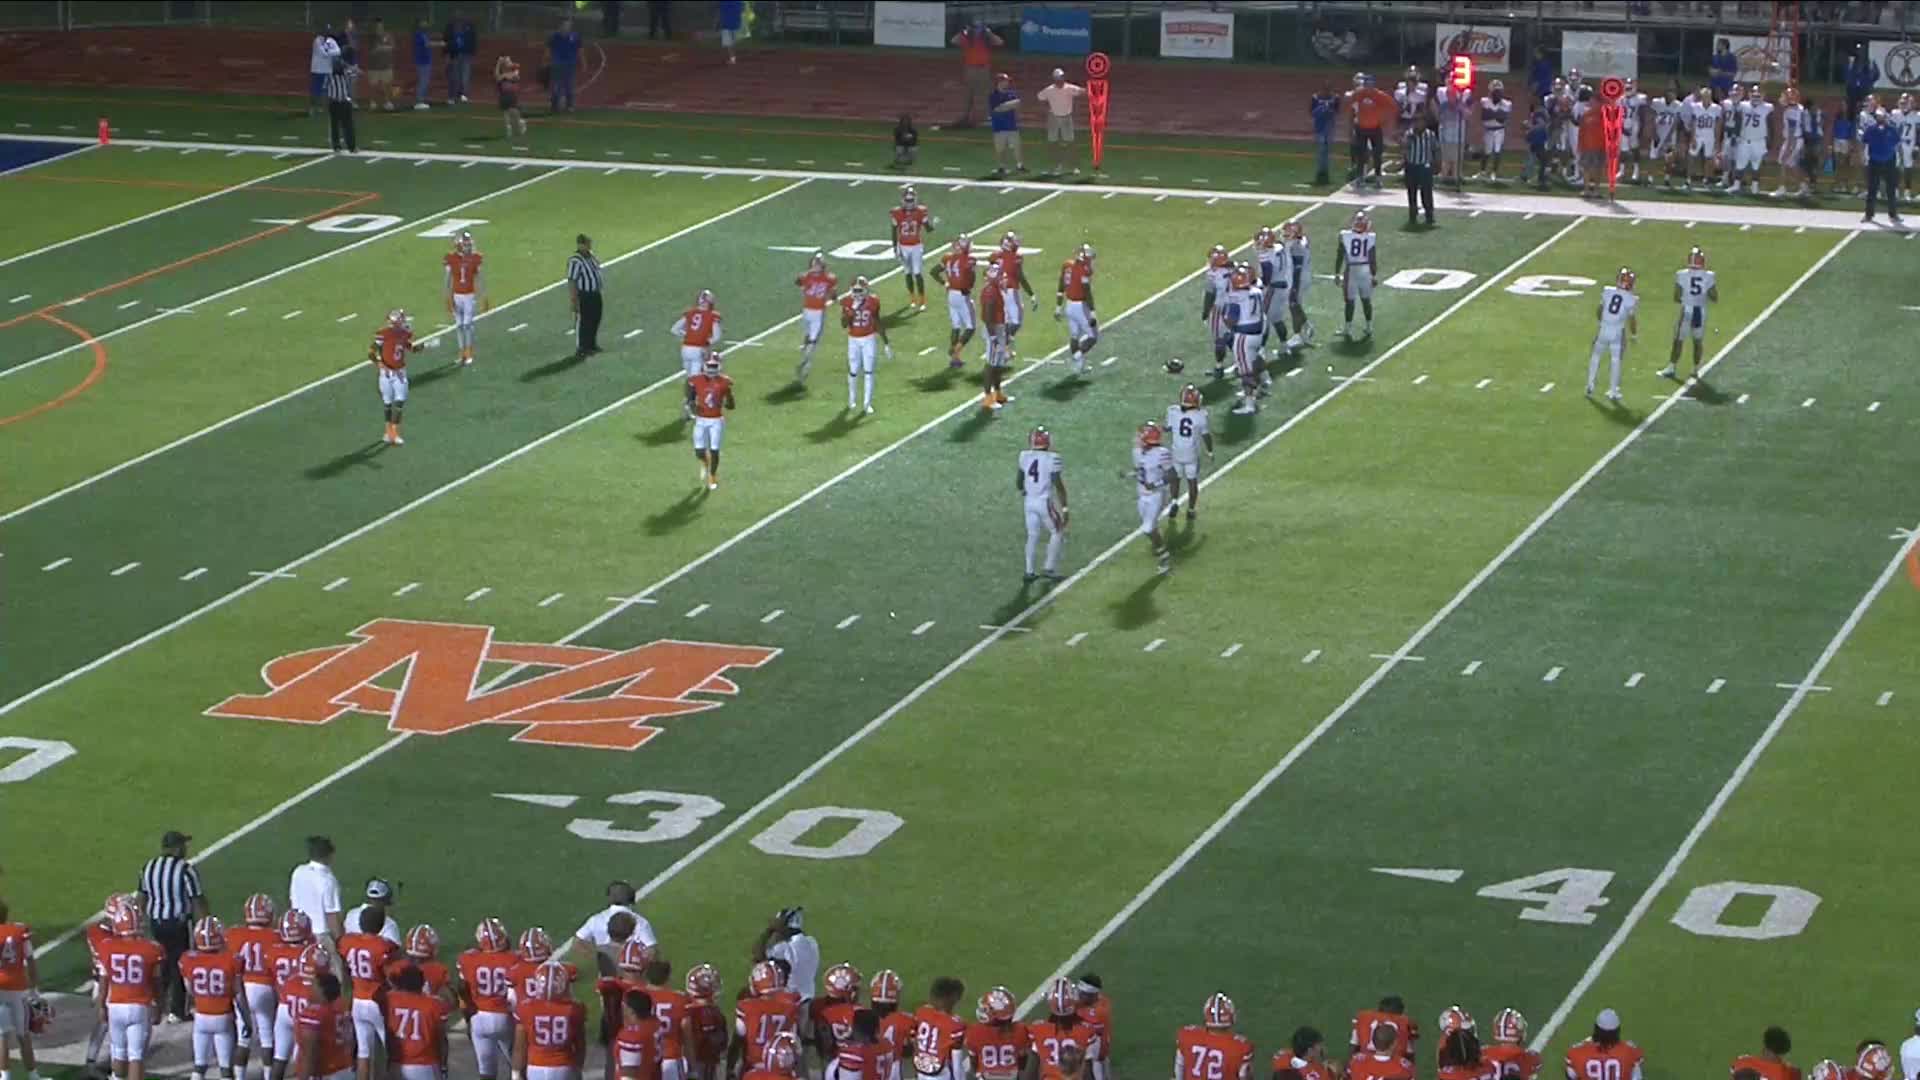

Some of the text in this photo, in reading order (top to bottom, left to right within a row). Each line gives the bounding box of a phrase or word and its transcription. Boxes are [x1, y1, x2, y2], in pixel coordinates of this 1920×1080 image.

[1454, 55, 1471, 87] 3
[1744, 113, 1760, 128] 75
[1351, 238, 1369, 257] 81
[1384, 268, 1477, 290] 0
[1690, 276, 1703, 296] 5
[1608, 294, 1623, 315] 8
[691, 313, 704, 331] 9
[704, 390, 715, 409] 4
[1179, 417, 1193, 437] 6
[1028, 458, 1040, 484] 4
[110, 953, 144, 984] 56
[346, 948, 373, 980] 46
[192, 966, 225, 995] 28
[389, 1007, 422, 1041] 71
[535, 1015, 569, 1046] 58
[755, 1013, 787, 1045] 17
[981, 1044, 1015, 1069] 86
[1192, 1045, 1224, 1080] 72
[1585, 1058, 1620, 1080] 90
